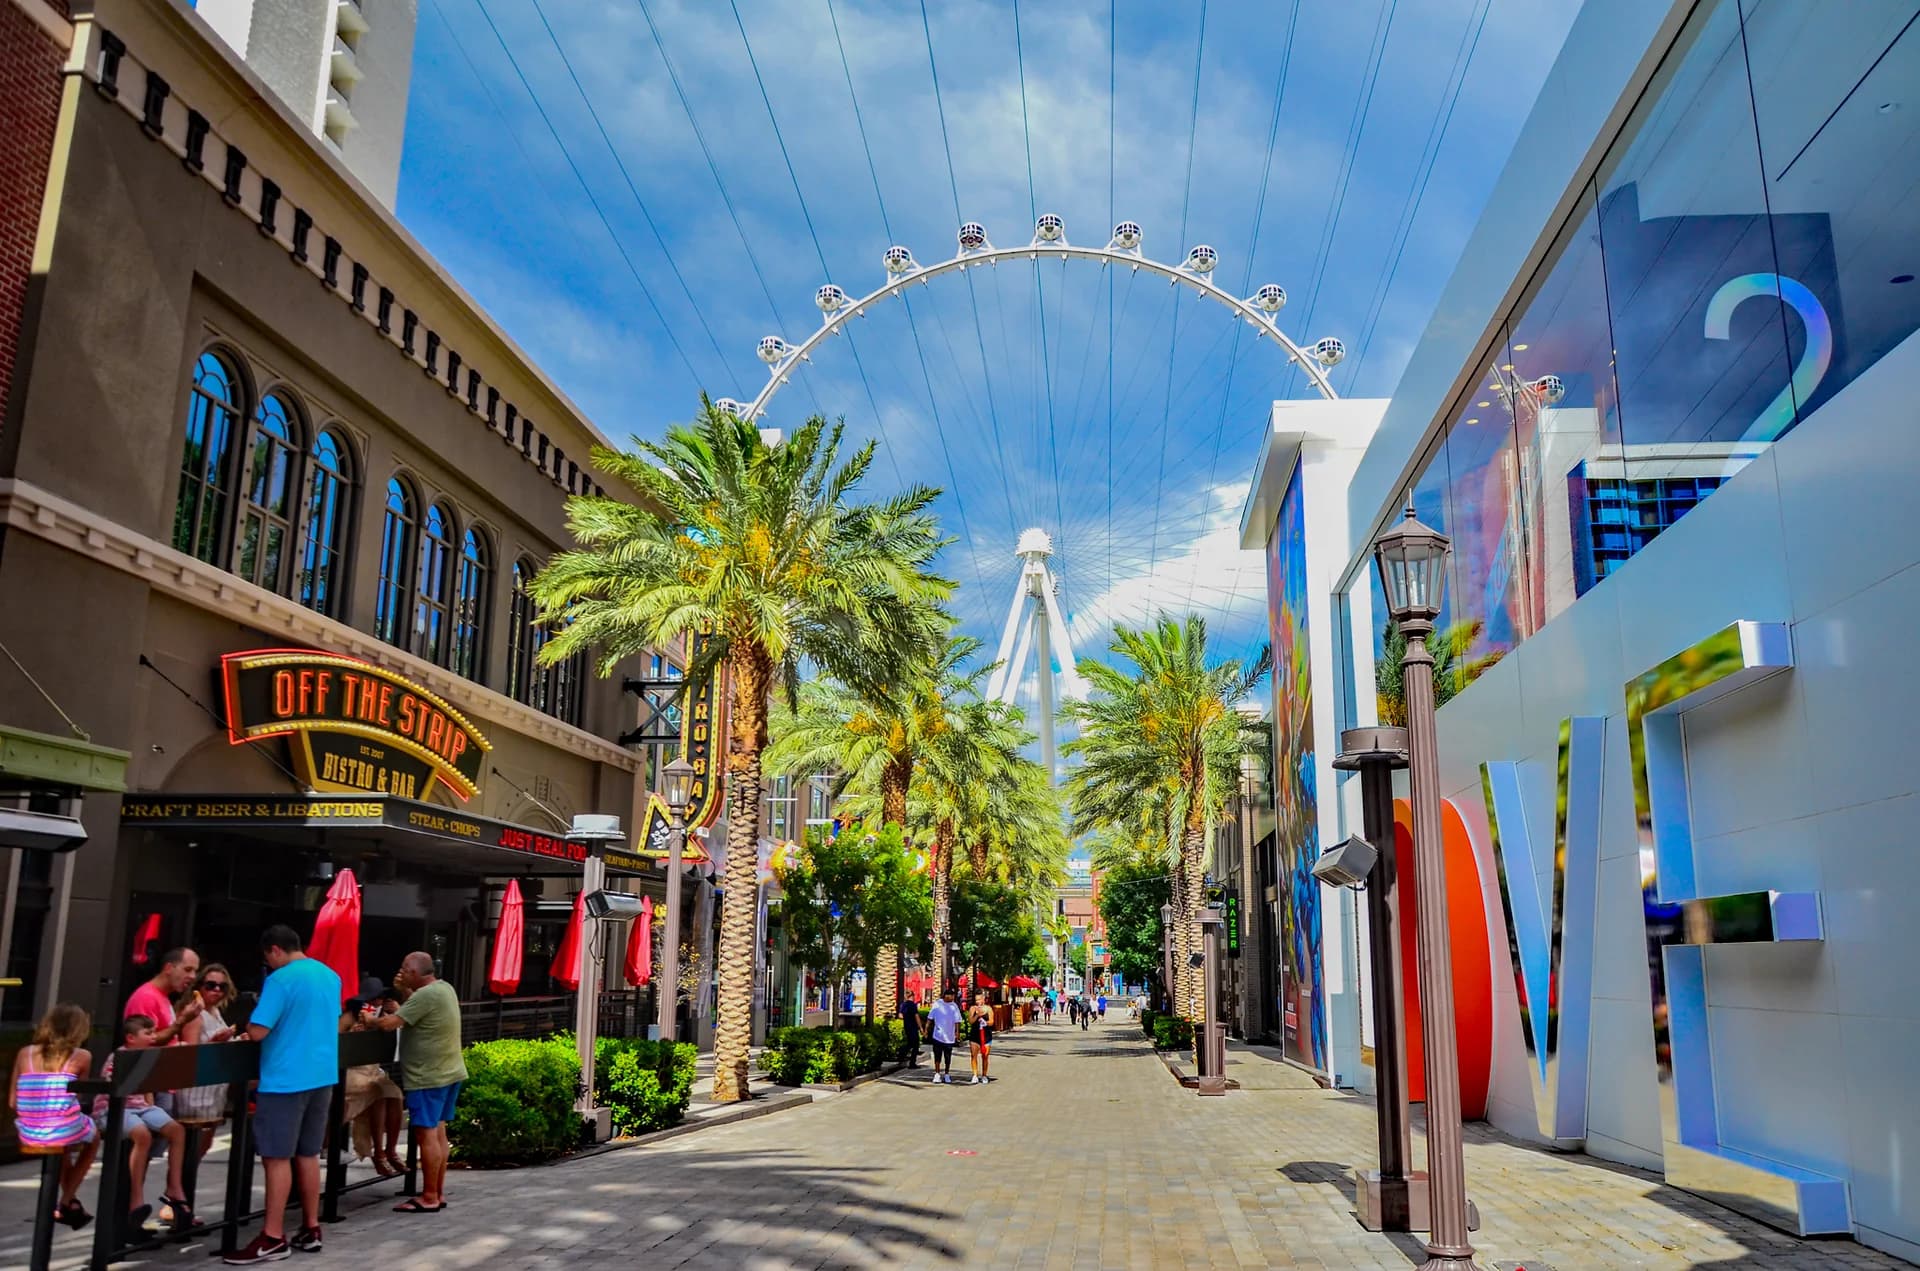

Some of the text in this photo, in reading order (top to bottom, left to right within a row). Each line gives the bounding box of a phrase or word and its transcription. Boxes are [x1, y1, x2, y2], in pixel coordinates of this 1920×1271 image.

[693, 617, 712, 742] BIRO
[274, 669, 469, 765] OFF THE STRIP
[322, 752, 415, 799] BISTRO & BAR
[121, 803, 383, 818] CRAFT BEER & LIBATIONS
[408, 811, 480, 837] STEAK CHOPS
[498, 828, 587, 862] JUST REAL FOO
[1228, 898, 1238, 949] RAZER
